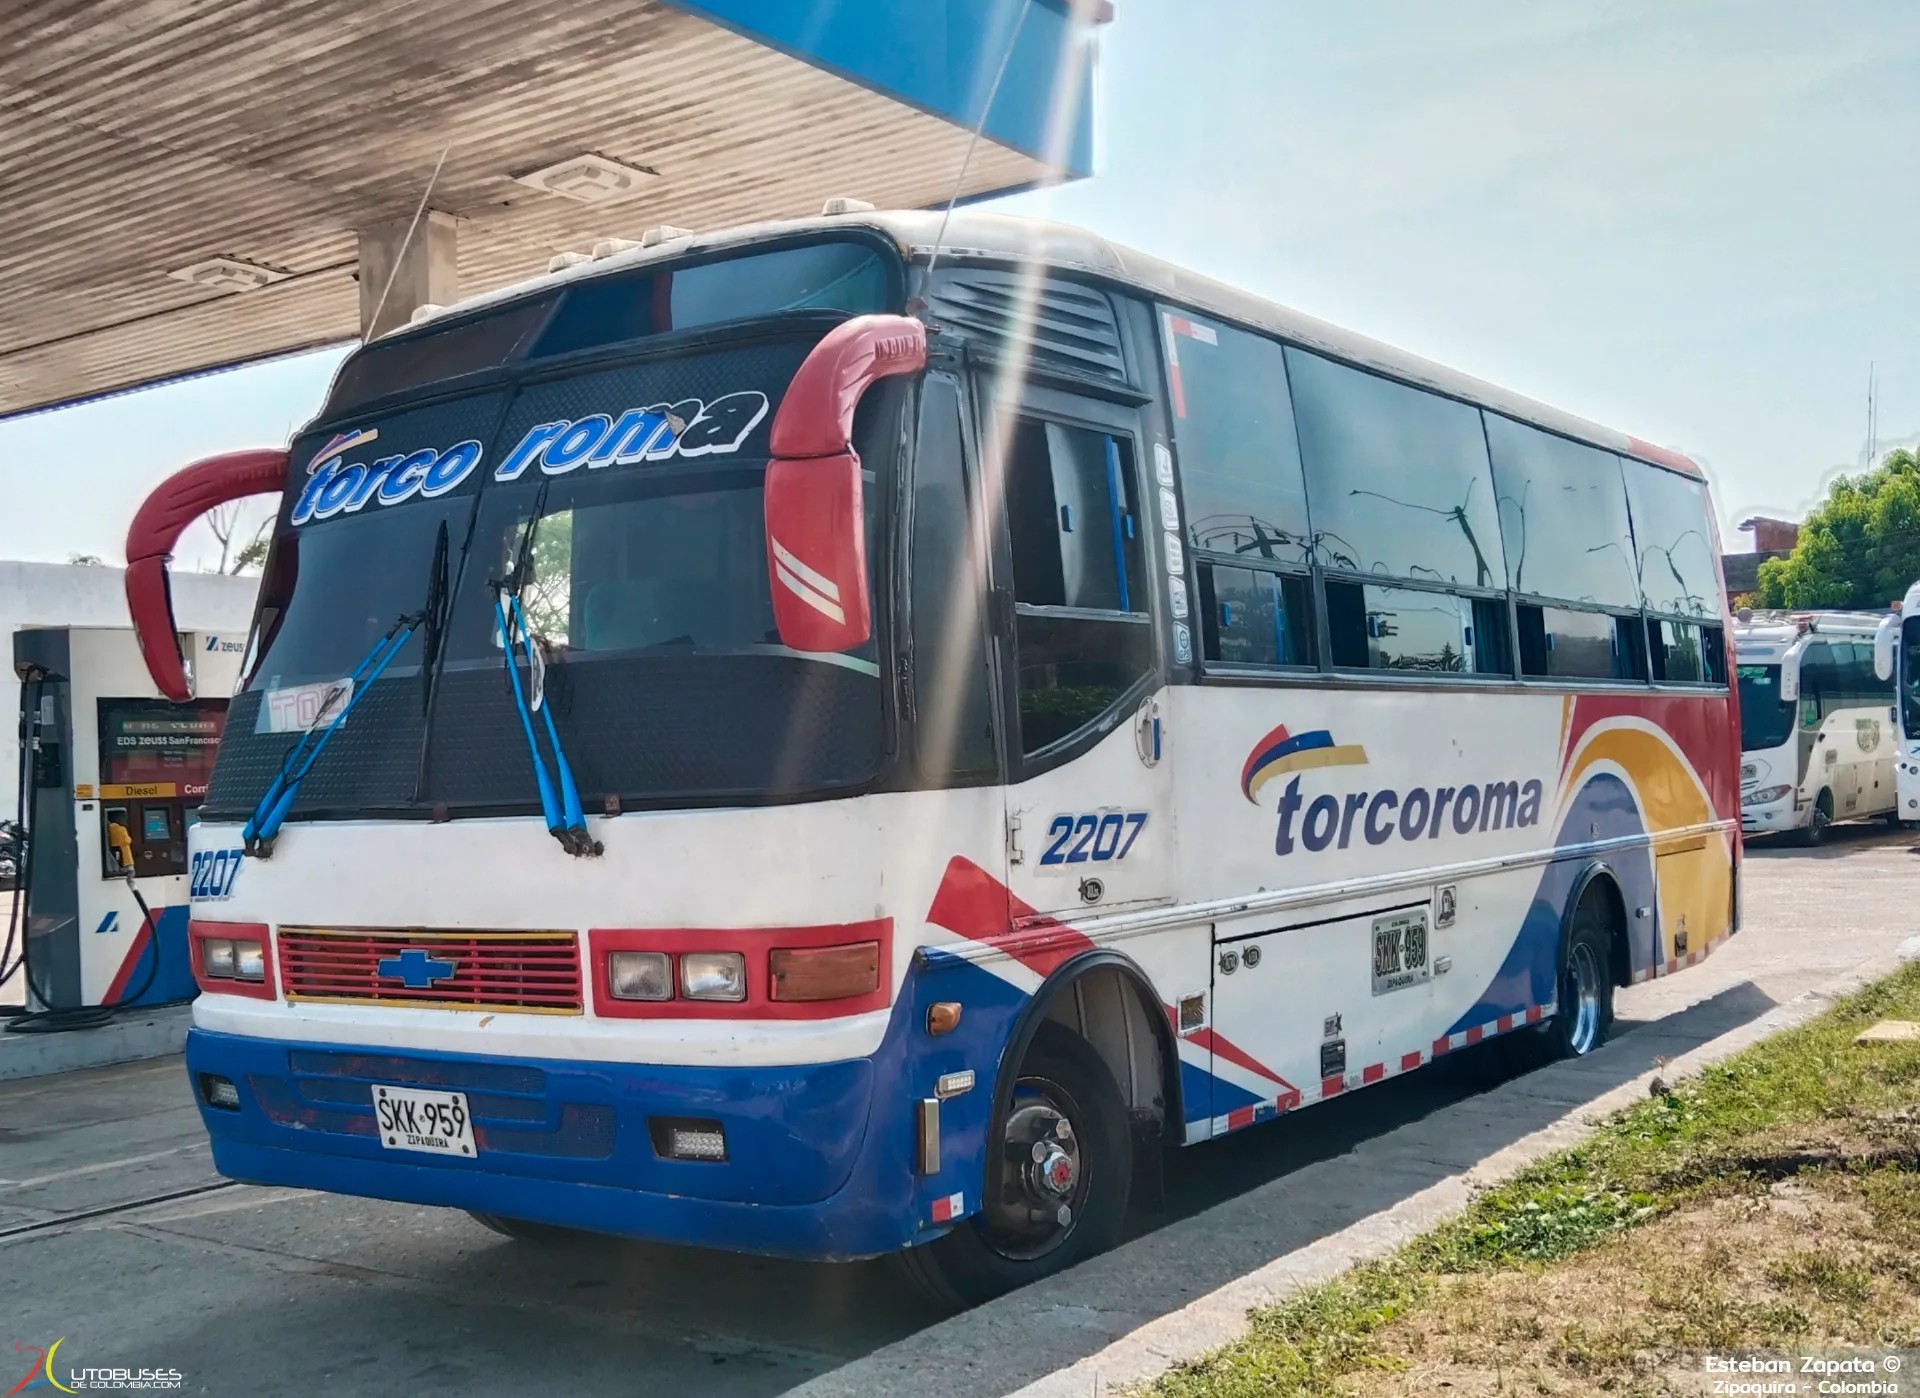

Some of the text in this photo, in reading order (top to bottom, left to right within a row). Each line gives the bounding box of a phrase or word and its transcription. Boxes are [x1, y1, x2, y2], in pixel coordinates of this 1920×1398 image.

[291, 390, 769, 526] torco roma
[221, 640, 245, 653] zeus
[117, 736, 137, 746] EDS
[168, 736, 222, 745] SanFrancisc
[125, 784, 158, 796] Diesel
[1275, 774, 1542, 856] torcoroma
[1040, 812, 1148, 866] 2207
[190, 848, 245, 899] 2207
[406, 1134, 450, 1148] ZIPAQUIRA
